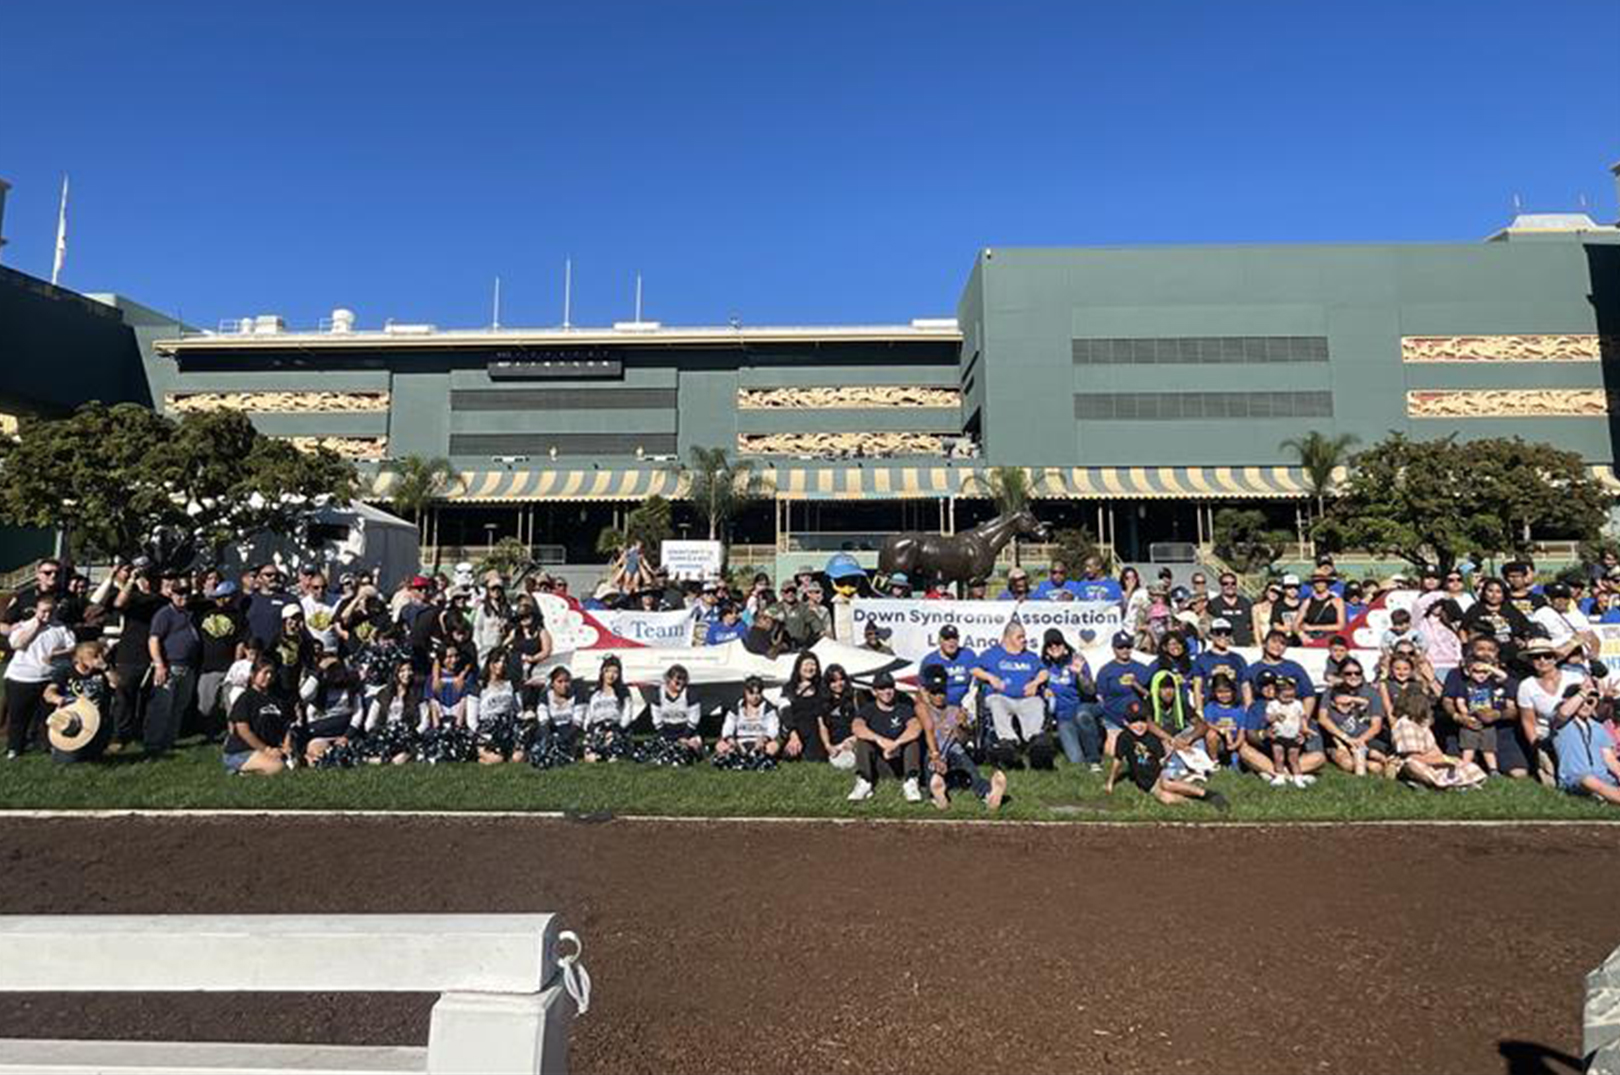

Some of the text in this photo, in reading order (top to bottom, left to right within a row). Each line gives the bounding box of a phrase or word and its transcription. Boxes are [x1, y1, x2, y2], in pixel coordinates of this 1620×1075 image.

[854, 609, 1118, 626] Down Syndrome Association
[630, 619, 685, 638] Team
